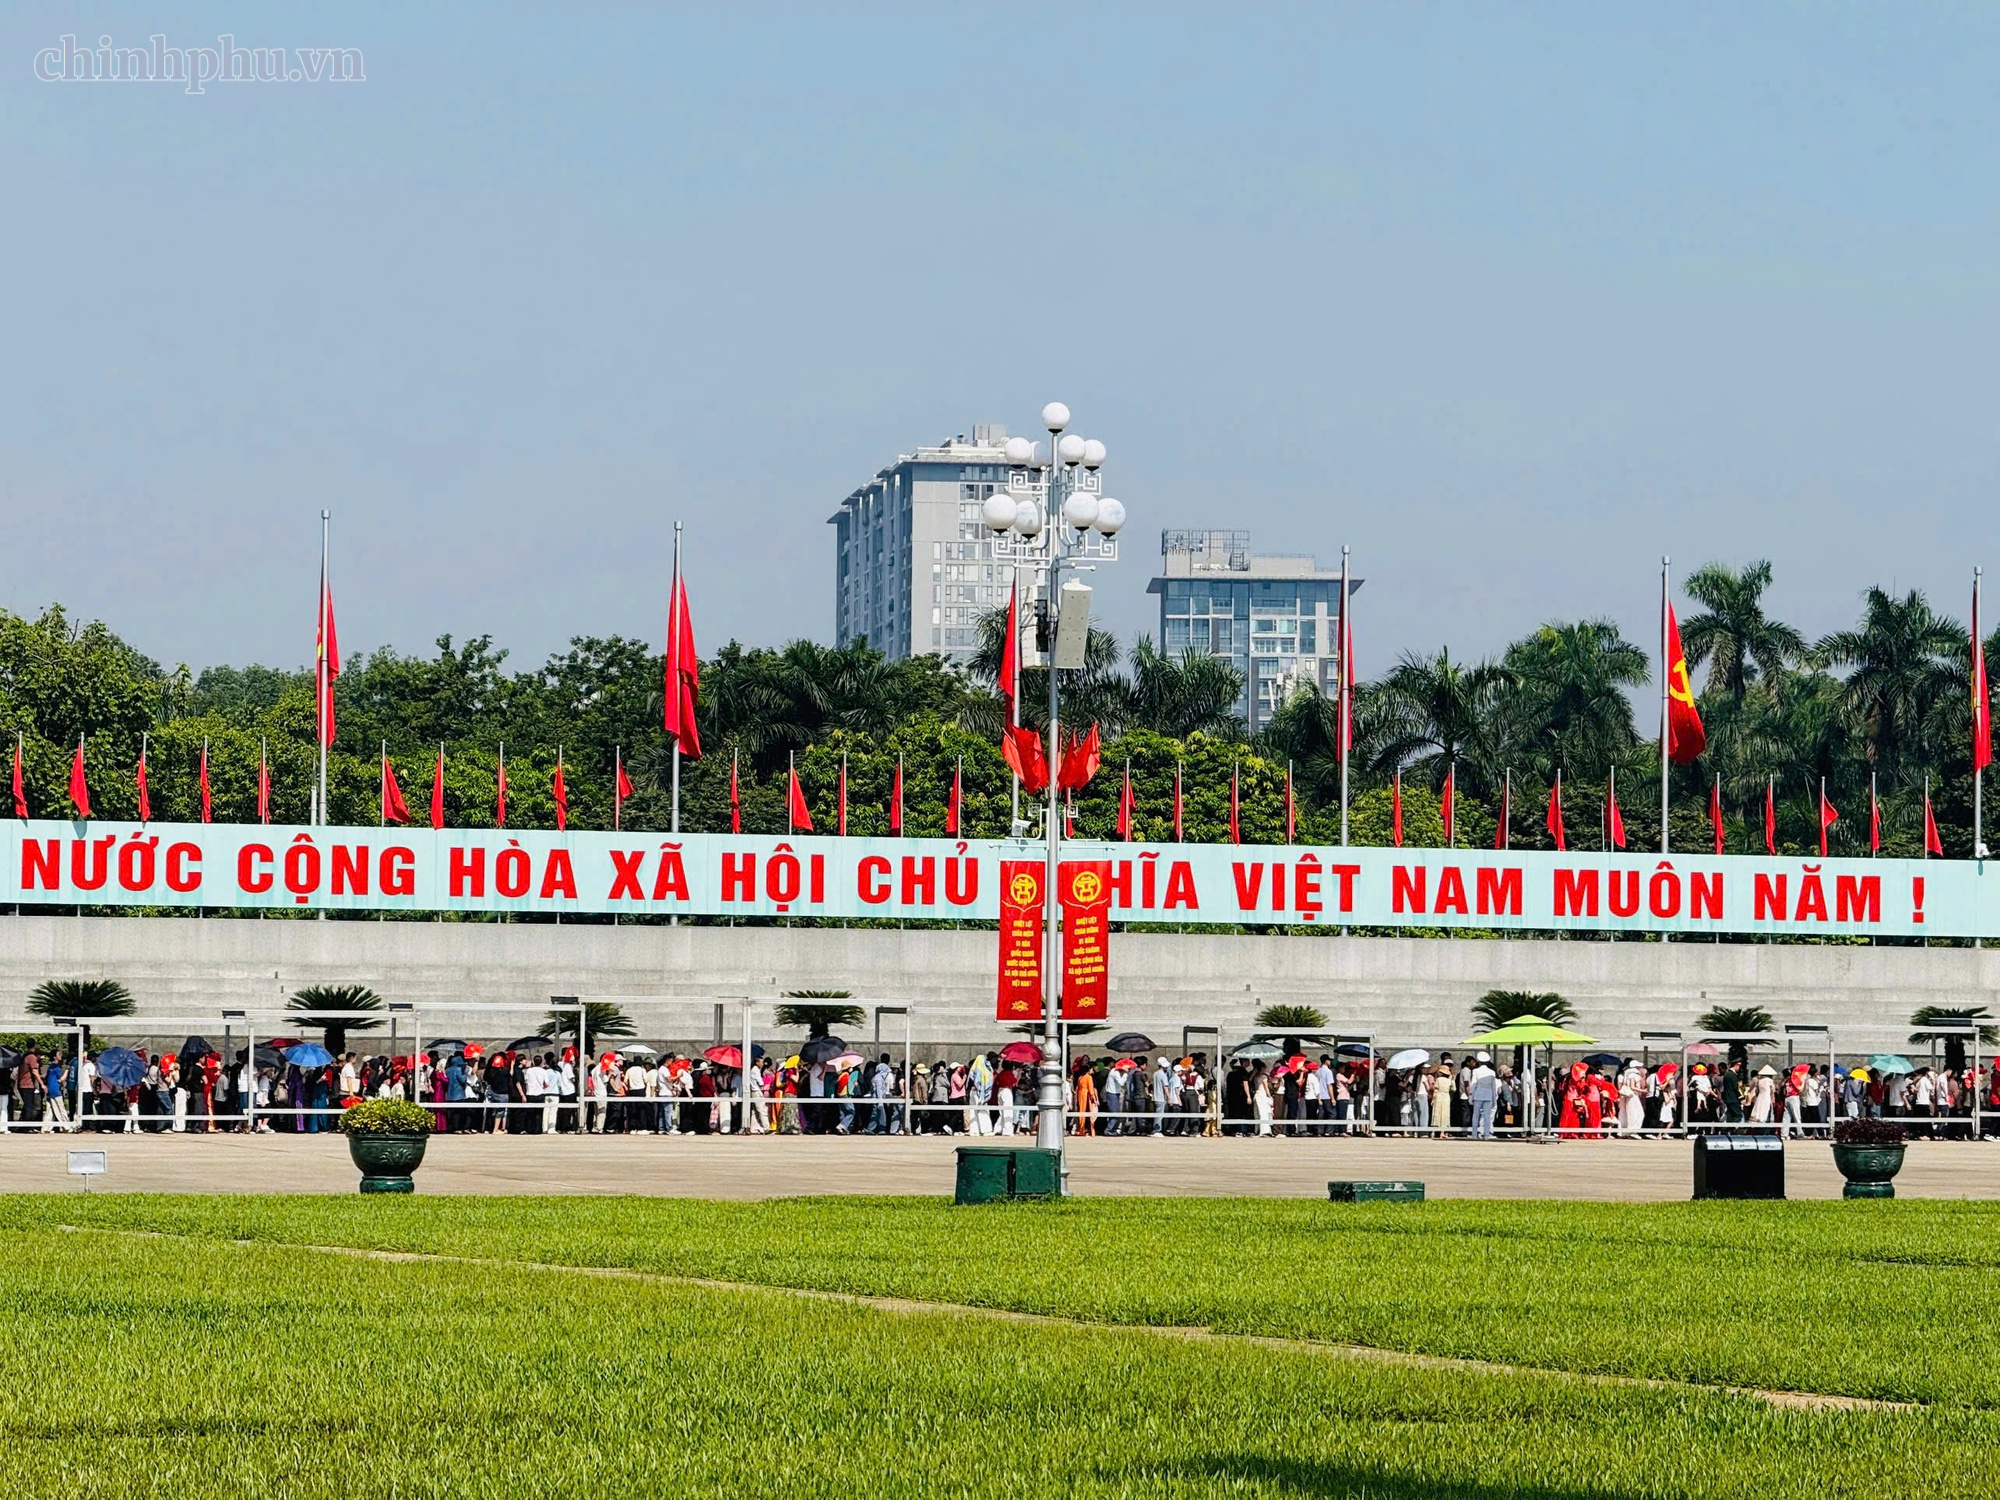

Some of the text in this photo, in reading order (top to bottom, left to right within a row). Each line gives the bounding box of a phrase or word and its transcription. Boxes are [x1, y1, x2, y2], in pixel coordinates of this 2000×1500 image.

[22, 832, 203, 893] NƯỚC
[237, 834, 415, 904] CỘNG
[449, 838, 577, 898] HÒA
[608, 842, 690, 901] XÃ
[721, 843, 825, 912] HỘI
[857, 842, 979, 905] CHỦ
[1232, 853, 1361, 921] VIỆT
[1392, 865, 1523, 915] NAM
[1553, 861, 1724, 920] MUÔN
[1754, 864, 1881, 923] NĂM
[1912, 876, 1925, 923] !
